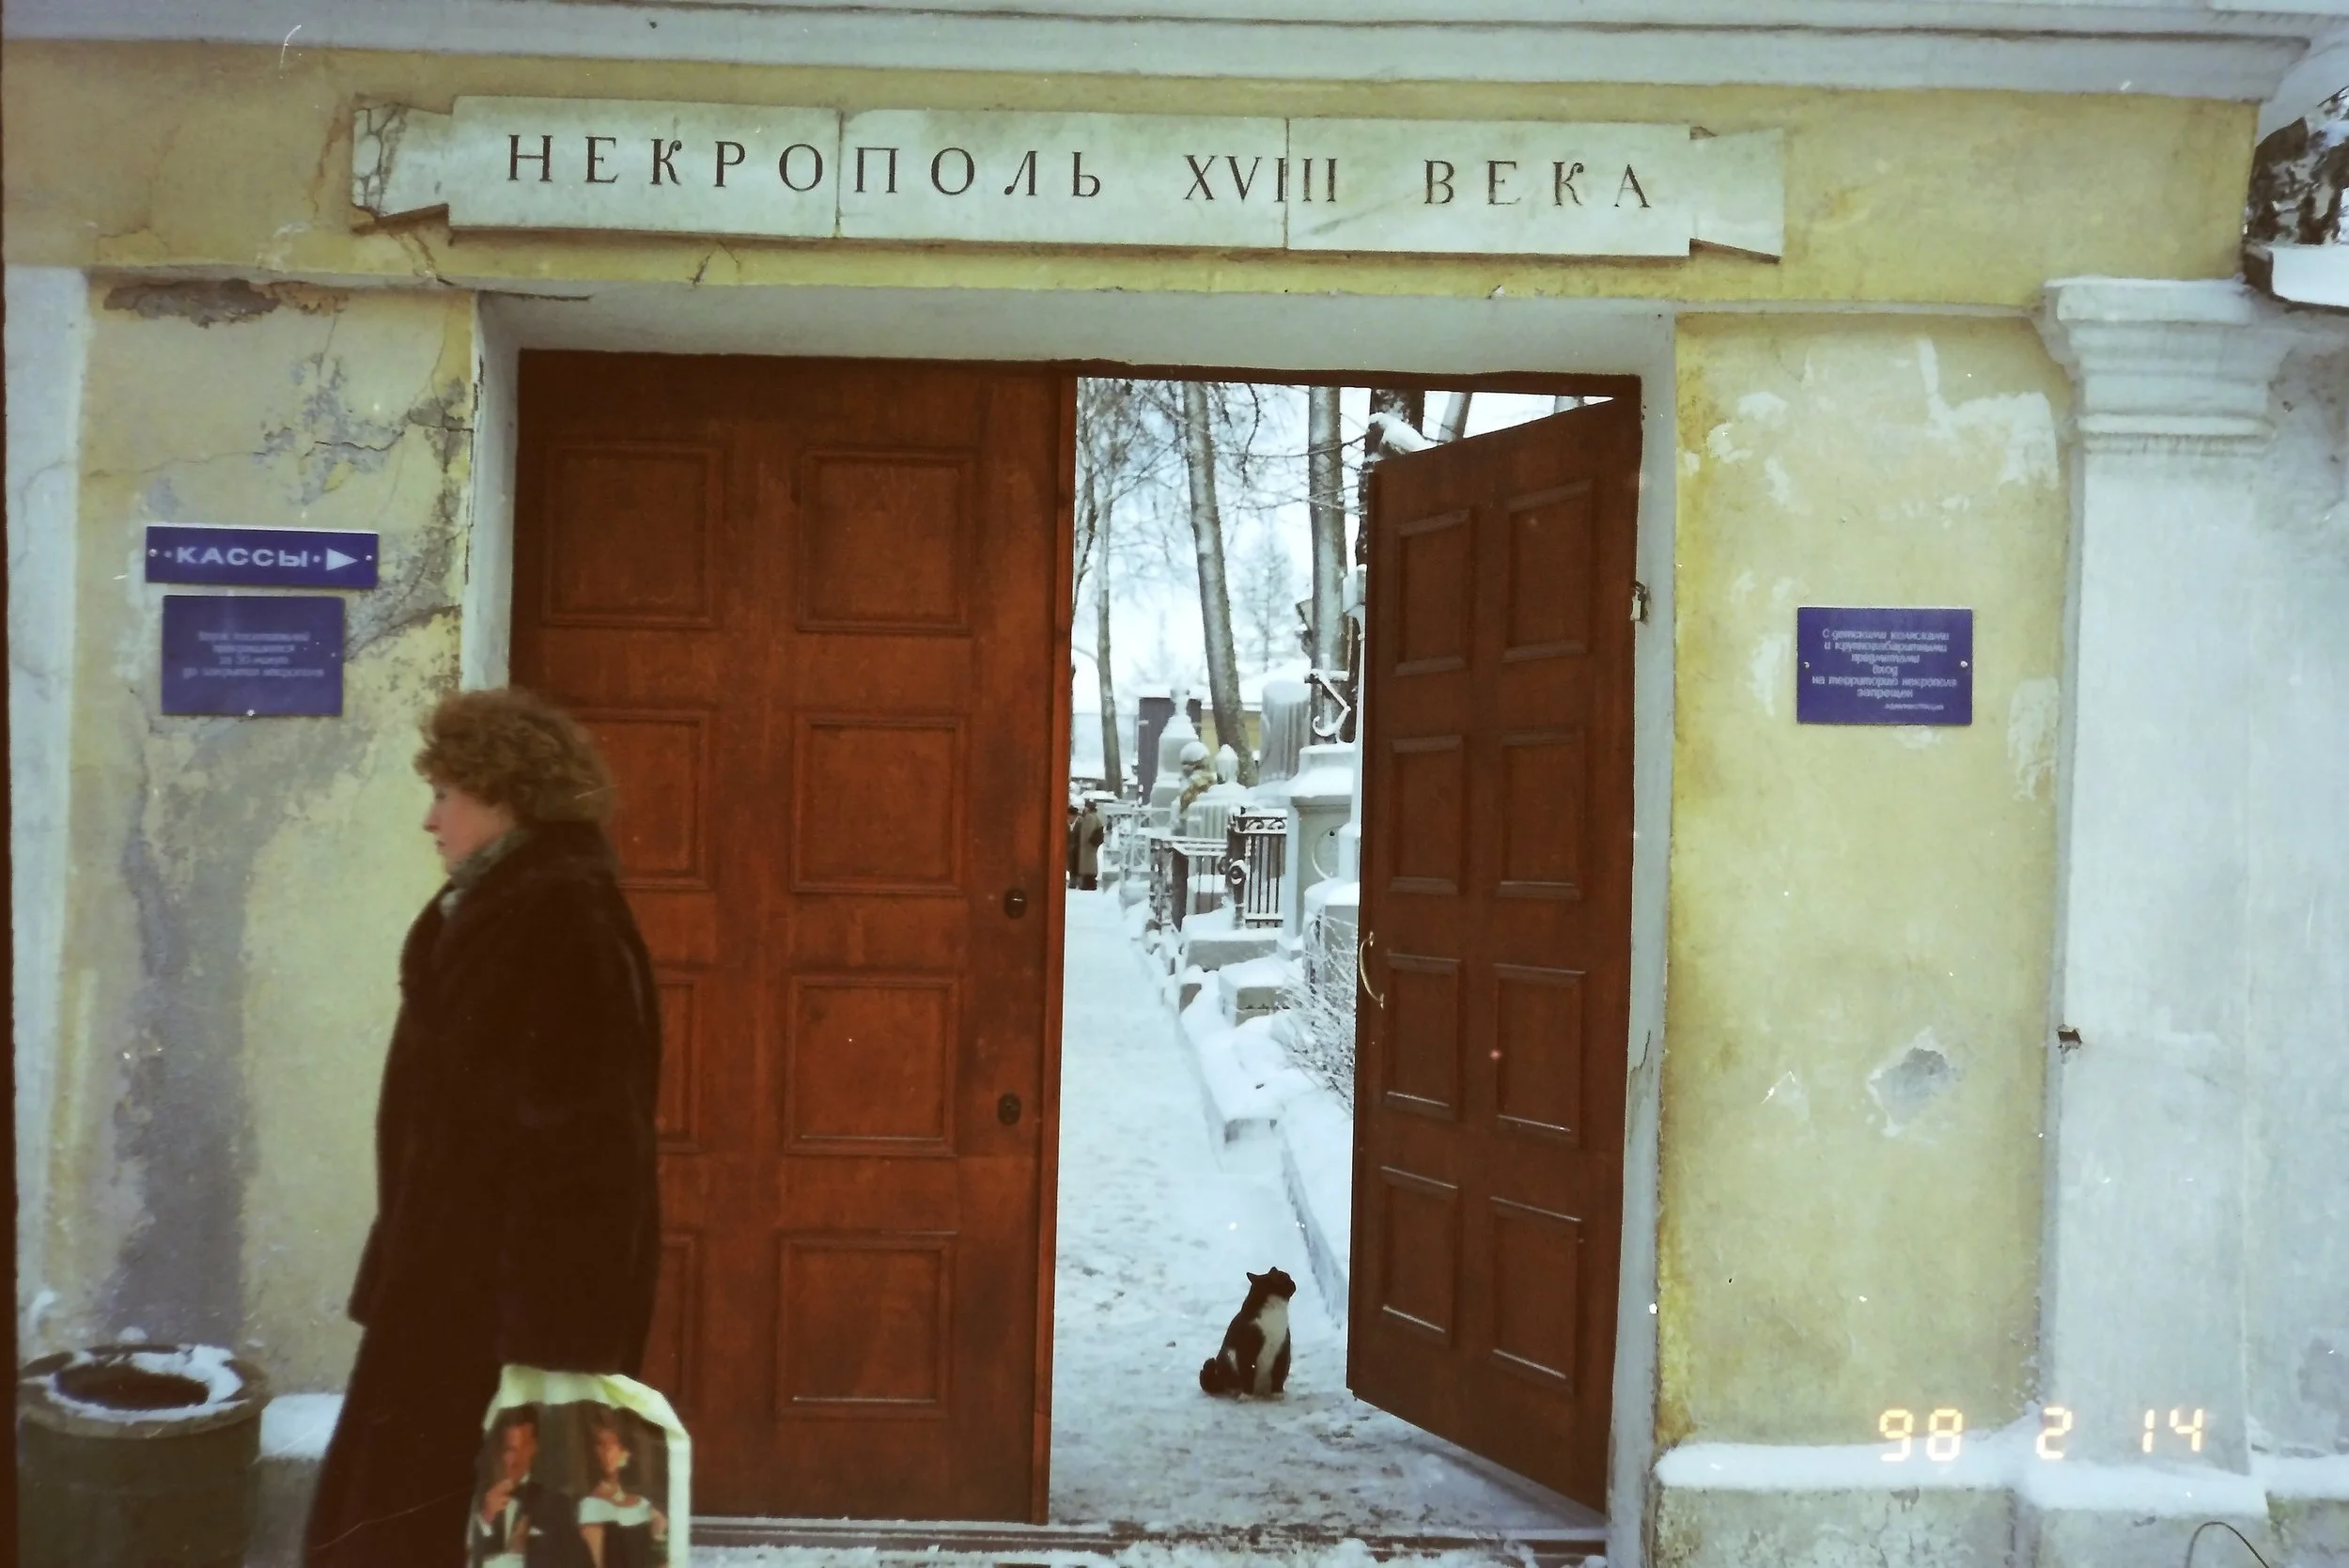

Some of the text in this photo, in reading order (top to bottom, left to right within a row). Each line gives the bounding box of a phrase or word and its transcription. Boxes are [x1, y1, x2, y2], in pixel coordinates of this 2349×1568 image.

[507, 134, 1651, 209] НЕКРОПОЛЬ XVIII ВЕКА
[176, 546, 308, 567] КАССЫ
[1812, 675, 1825, 685] на
